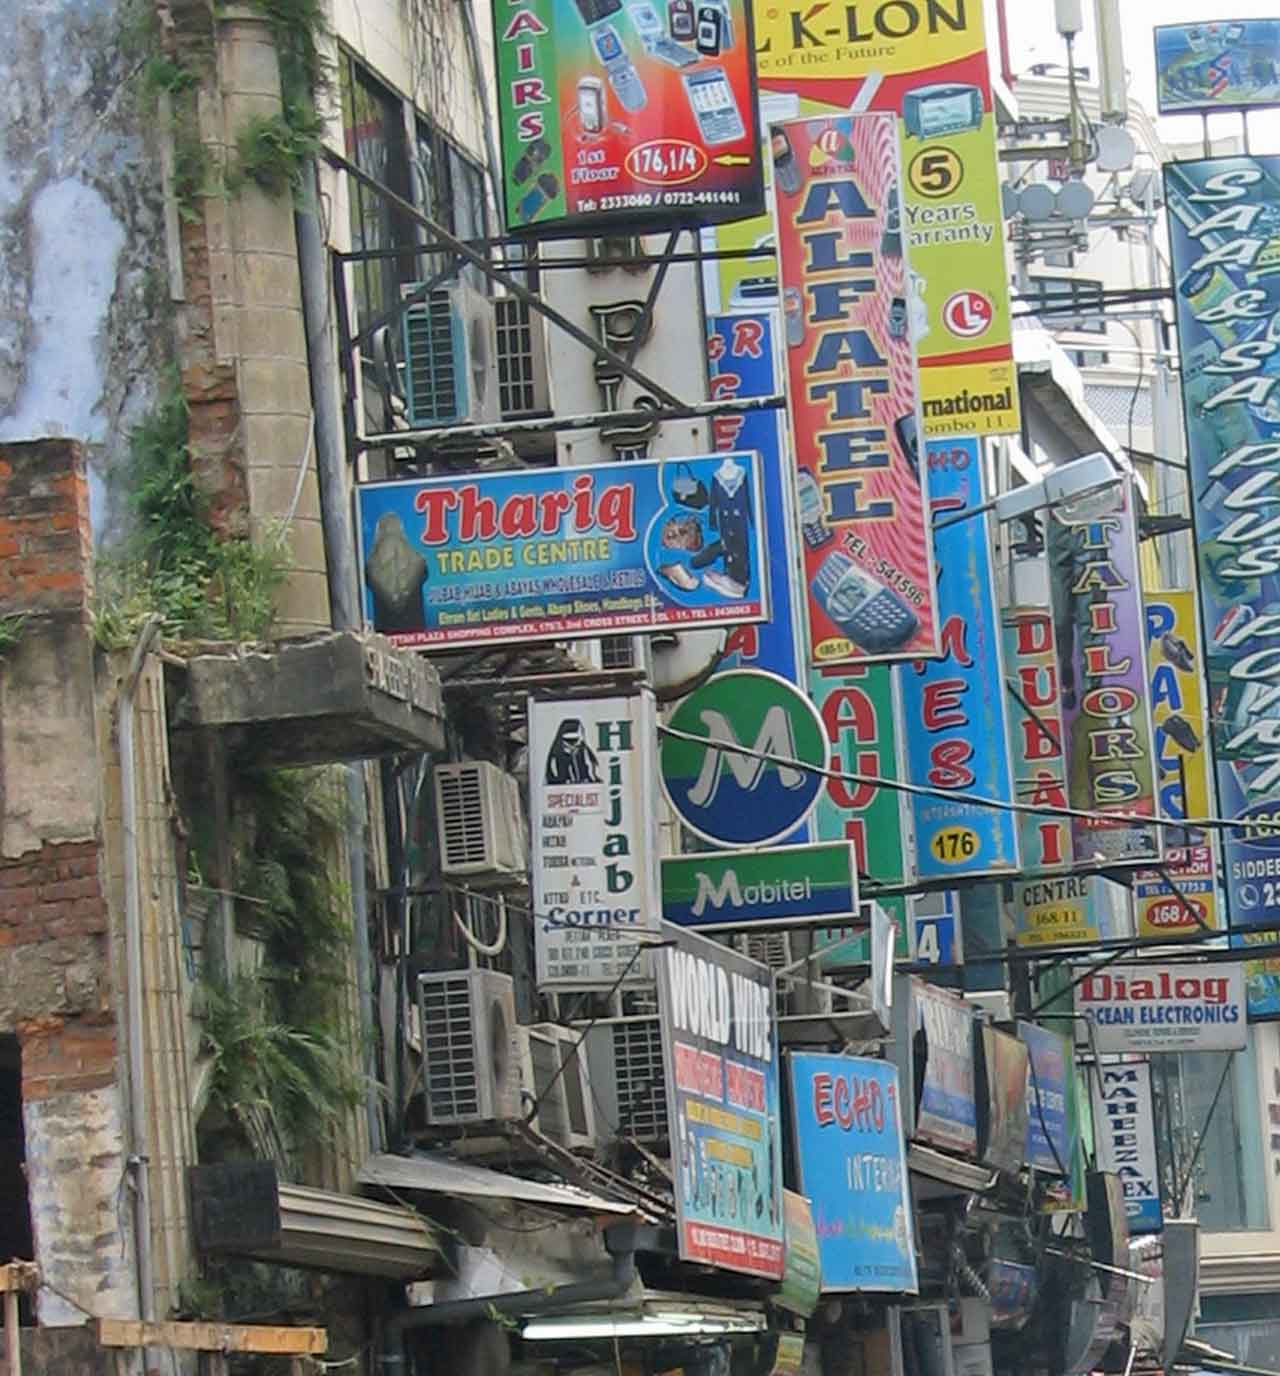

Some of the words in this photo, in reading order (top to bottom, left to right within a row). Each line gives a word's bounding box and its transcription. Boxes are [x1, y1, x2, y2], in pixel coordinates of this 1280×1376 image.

[790, 1, 966, 50] K-LON
[504, 0, 551, 142] AIRS
[801, 50, 831, 64] the
[836, 45, 896, 61] Future
[920, 155, 951, 190] 5
[905, 203, 975, 224] Years
[796, 180, 897, 526] ALFATEL
[415, 473, 639, 546] Thariq
[437, 547, 516, 575] TRADE
[521, 538, 612, 568] CENTRE
[874, 560, 924, 607] 541596
[1072, 520, 1142, 802] TAILORS
[1017, 611, 1069, 865] DUBAI
[934, 831, 975, 859] 176
[691, 868, 812, 917] Mobitel
[1022, 875, 1090, 907] CENTRE
[547, 907, 641, 936] Corner
[668, 947, 730, 1045] WORLD
[1080, 971, 1230, 1005] Dialog
[1085, 1006, 1136, 1027] OCEAN
[1140, 1004, 1240, 1026] ELECTRONICS
[813, 1072, 886, 1134] ECHO
